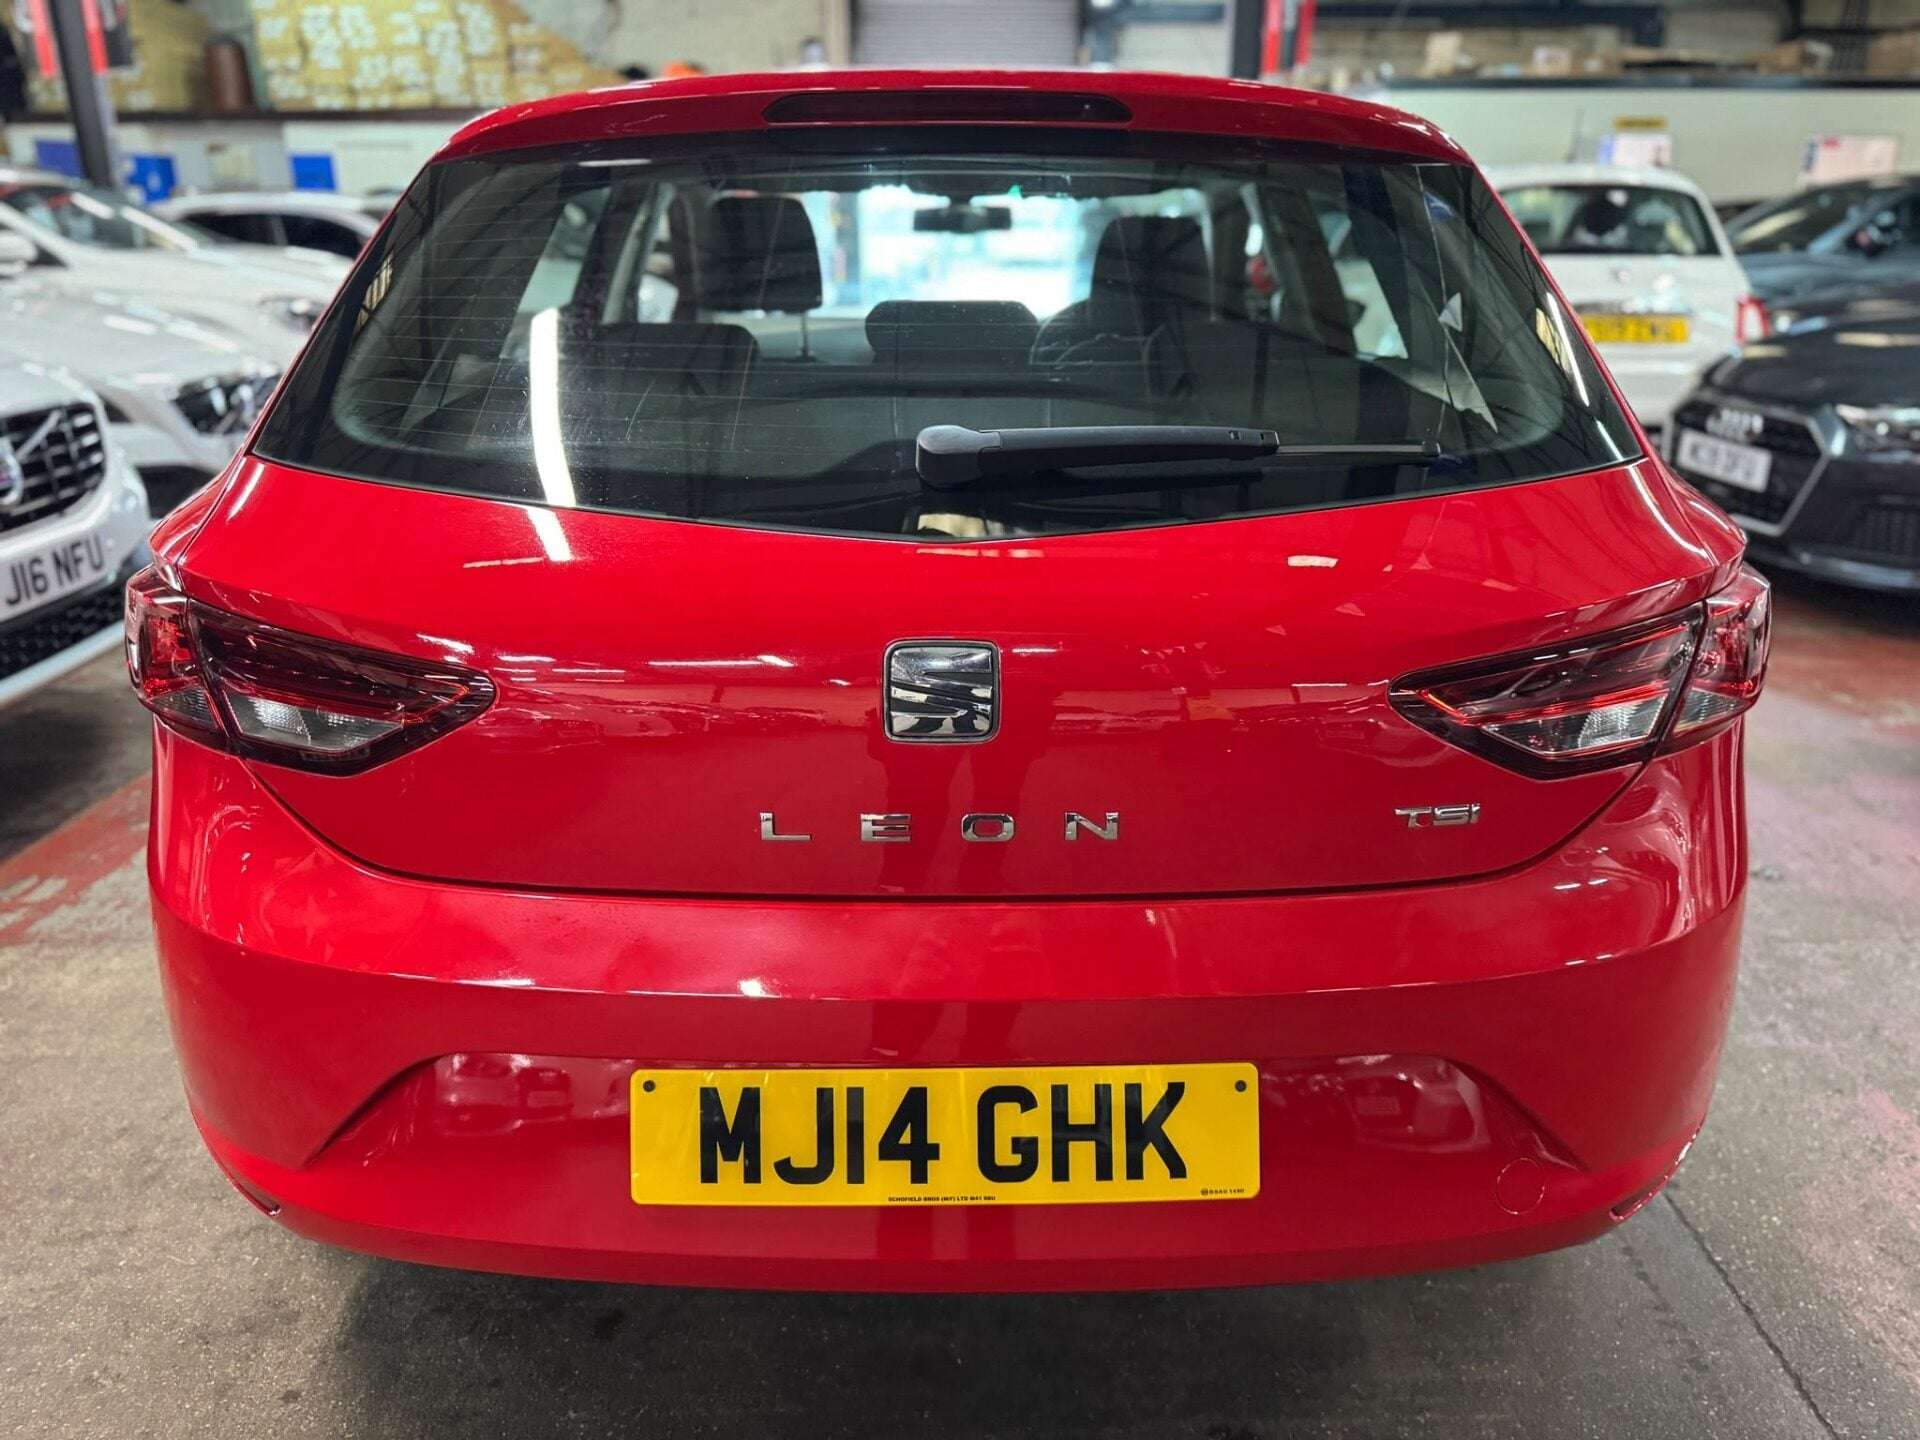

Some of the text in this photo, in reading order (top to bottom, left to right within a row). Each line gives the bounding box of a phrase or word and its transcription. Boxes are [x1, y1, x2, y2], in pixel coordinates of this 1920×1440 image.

[6, 533, 104, 605] J16 NFU
[760, 812, 1119, 841] LEON
[699, 1081, 1188, 1185] MJ14 GHK
